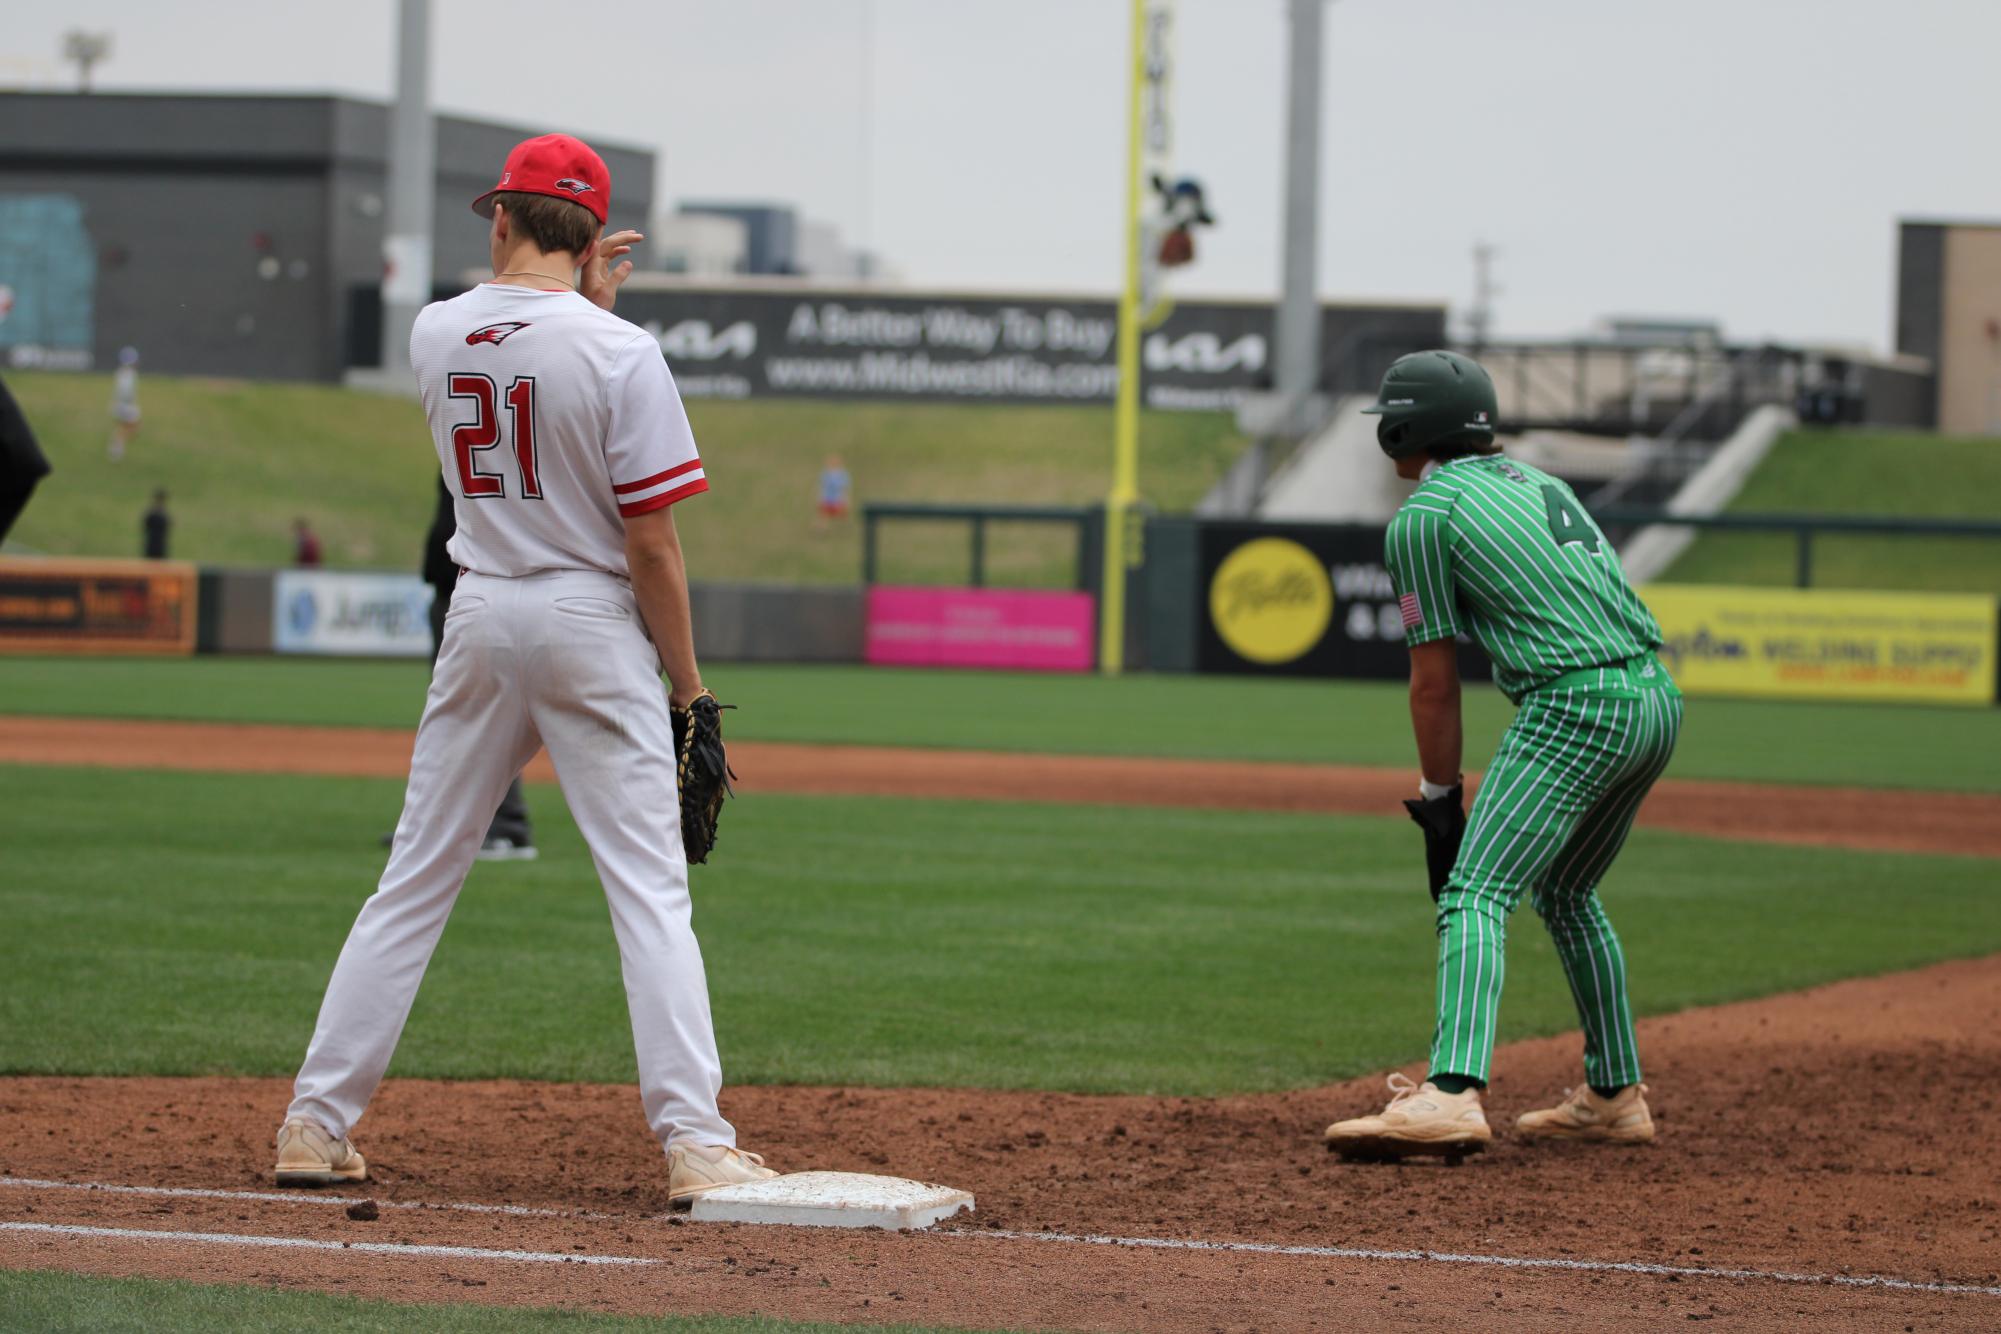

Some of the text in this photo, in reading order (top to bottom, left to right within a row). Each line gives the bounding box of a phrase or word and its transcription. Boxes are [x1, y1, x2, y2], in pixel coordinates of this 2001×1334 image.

[788, 304, 1115, 358] A Better Way To Buy
[448, 372, 543, 500] 21
[1540, 484, 1600, 553] 4
[1345, 602, 1376, 641] &
